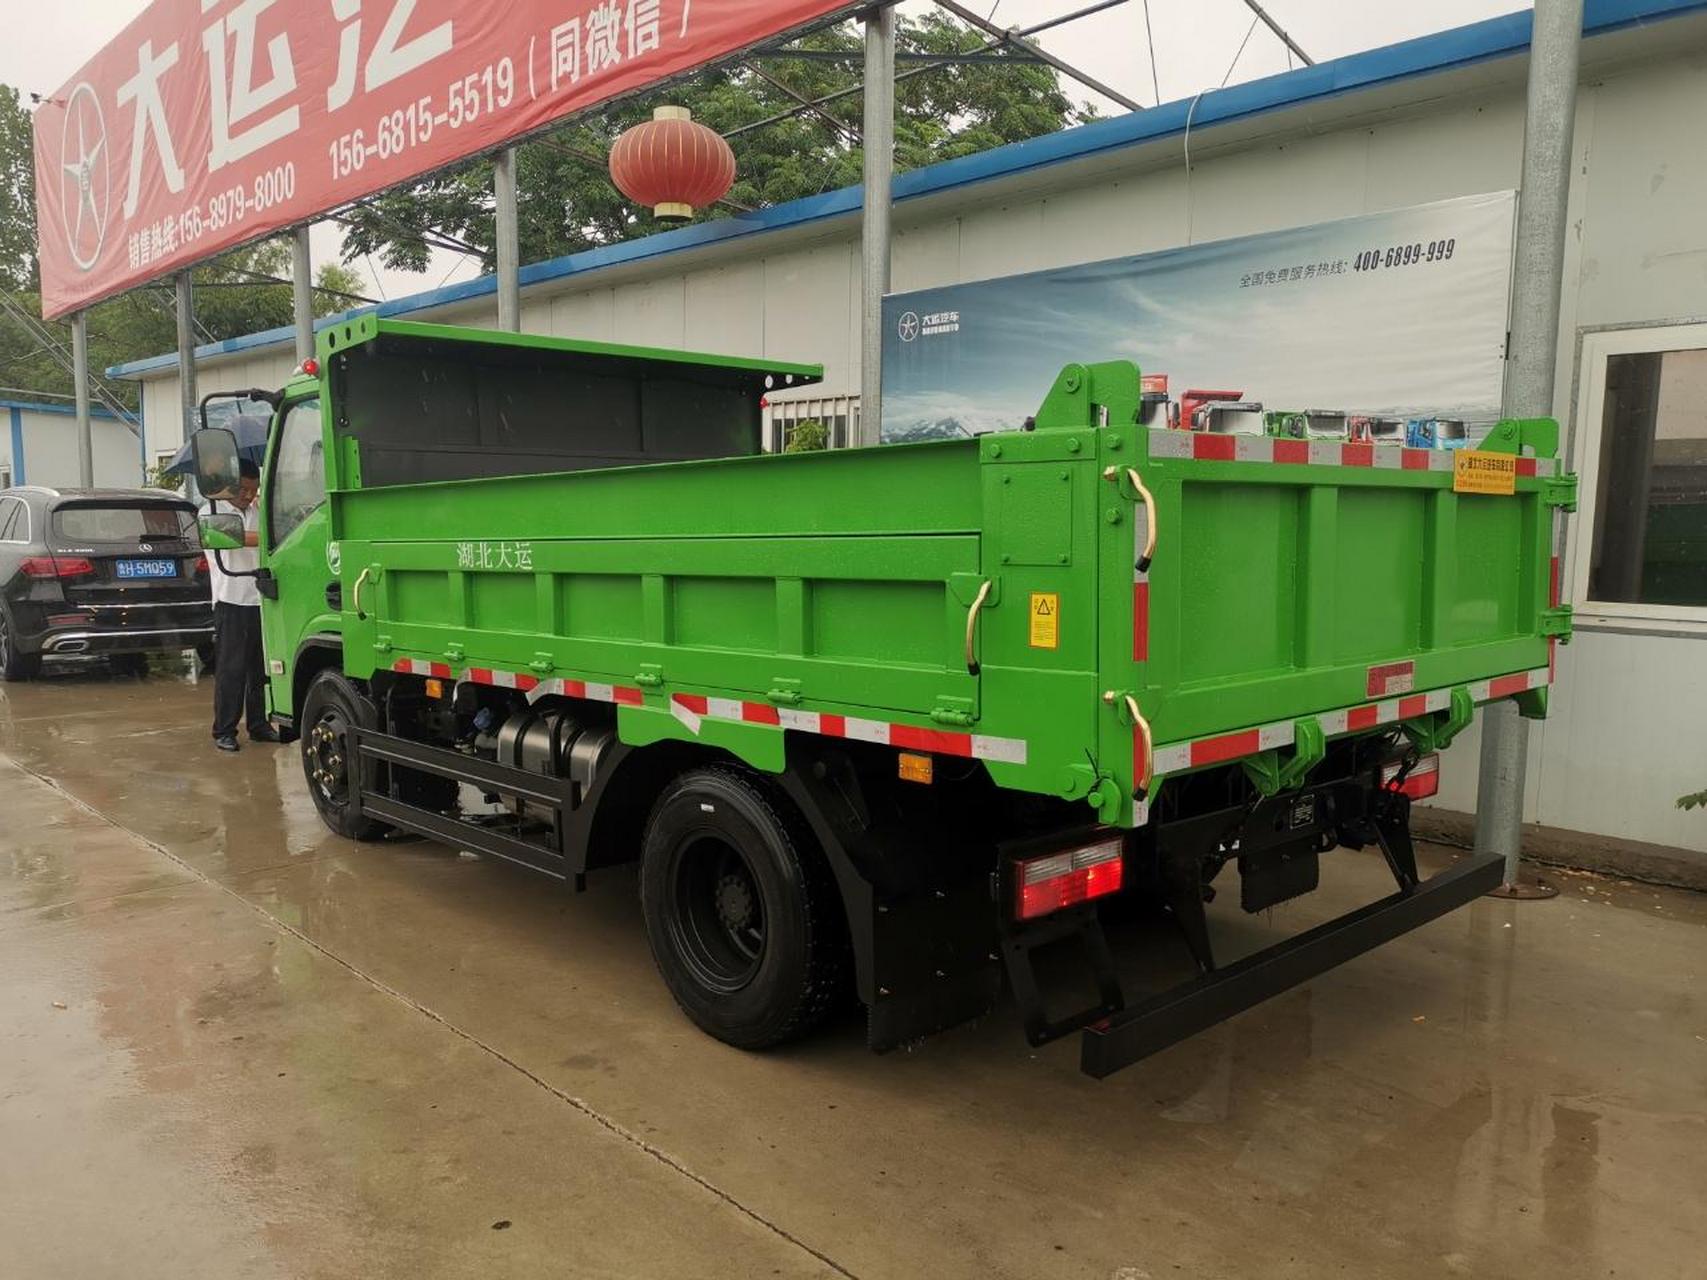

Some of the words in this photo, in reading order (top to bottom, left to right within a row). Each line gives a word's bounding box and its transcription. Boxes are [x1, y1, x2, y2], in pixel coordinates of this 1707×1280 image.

[1354, 238, 1455, 272] 400-6899-999
[456, 541, 534, 570] 湖北大运
